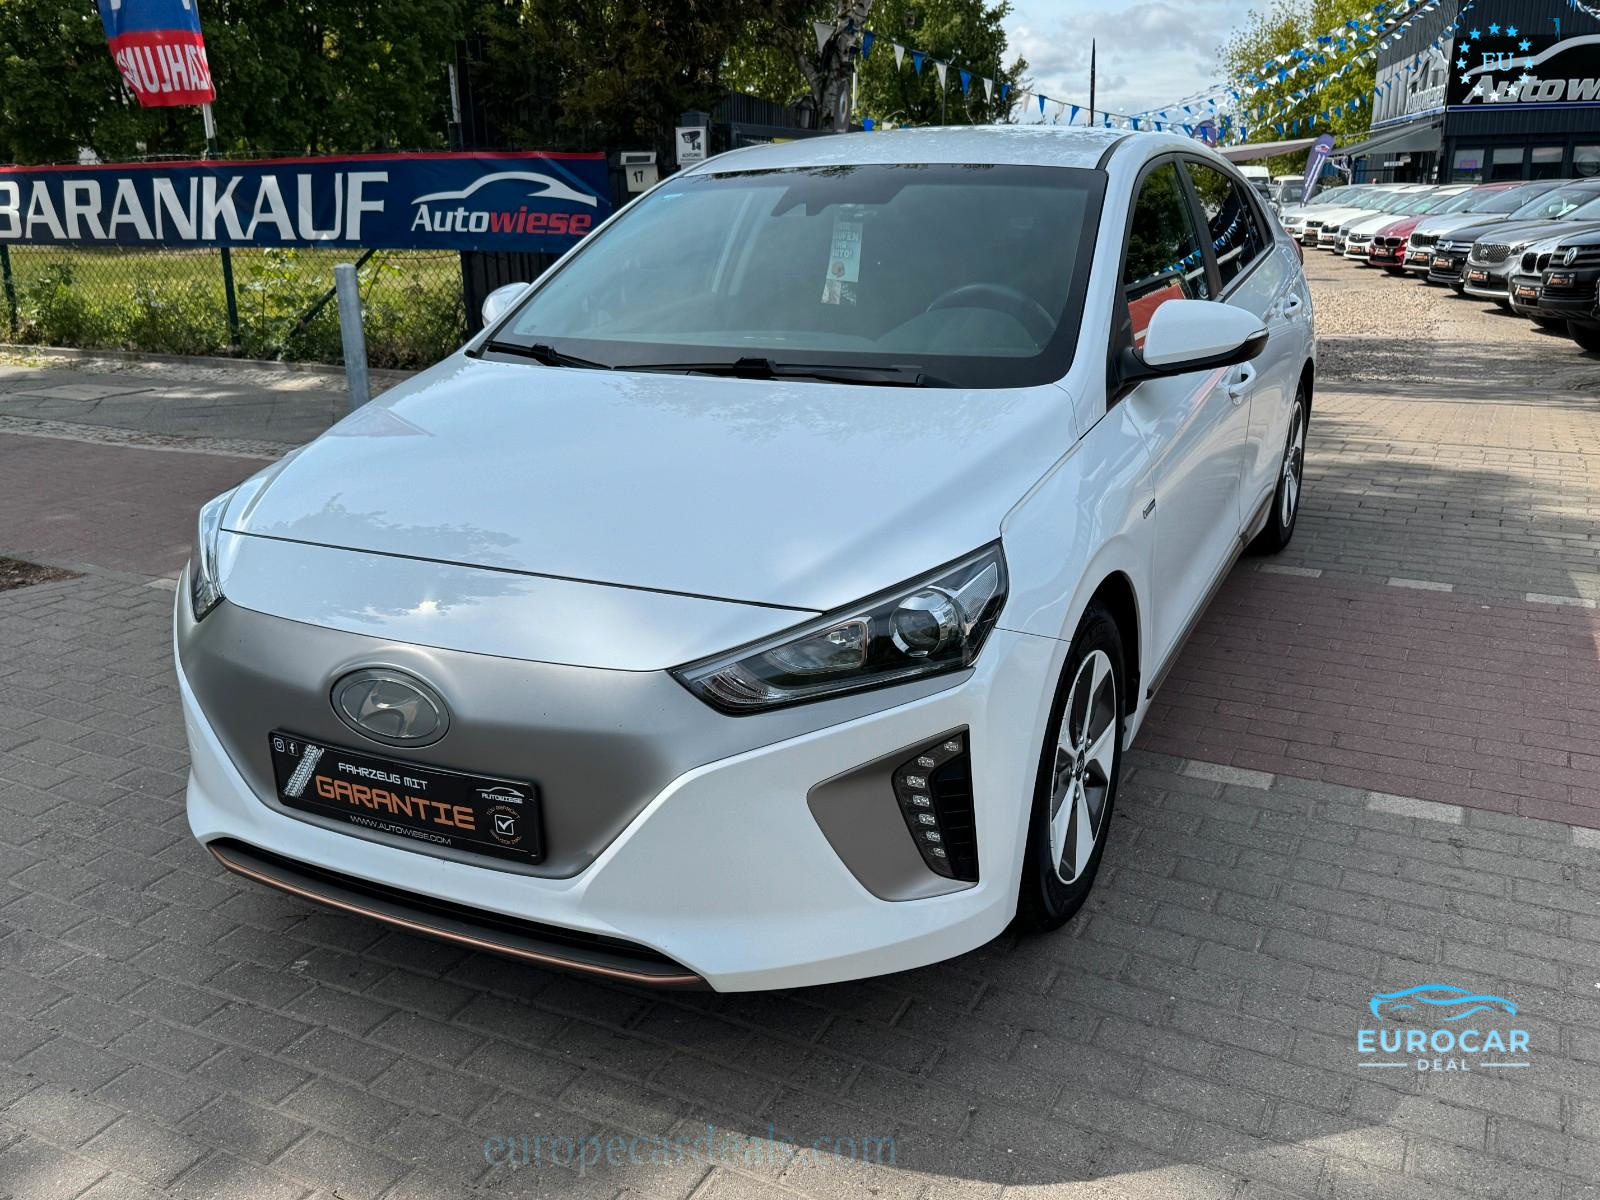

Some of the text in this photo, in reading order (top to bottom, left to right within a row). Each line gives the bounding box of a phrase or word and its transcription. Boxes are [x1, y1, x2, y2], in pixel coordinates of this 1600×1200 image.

[633, 170, 644, 183] 17
[0, 171, 389, 241] BARANKAUF
[410, 204, 592, 235] Autowiese
[338, 762, 428, 790] FAHRZEUG MIT
[315, 775, 476, 831] GARANTIE
[350, 815, 452, 846] WWW.AUTOWIESE.COM
